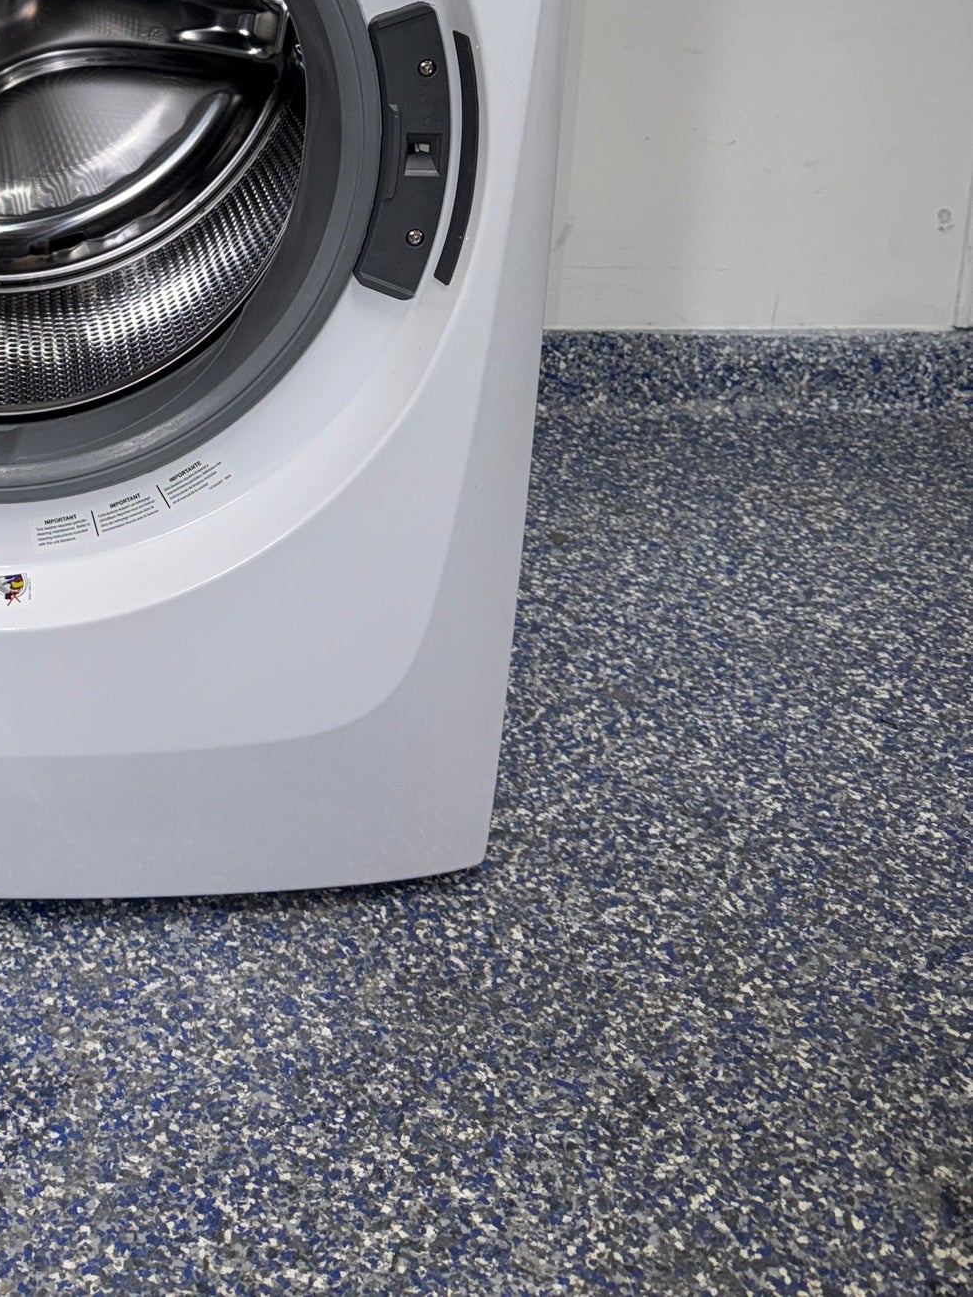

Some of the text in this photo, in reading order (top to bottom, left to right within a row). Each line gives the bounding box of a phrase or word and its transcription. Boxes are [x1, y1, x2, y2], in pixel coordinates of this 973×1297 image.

[168, 460, 202, 482] IMPORTANTE
[109, 493, 141, 508] IMPORTANT
[44, 514, 77, 524] IMPORTANT
